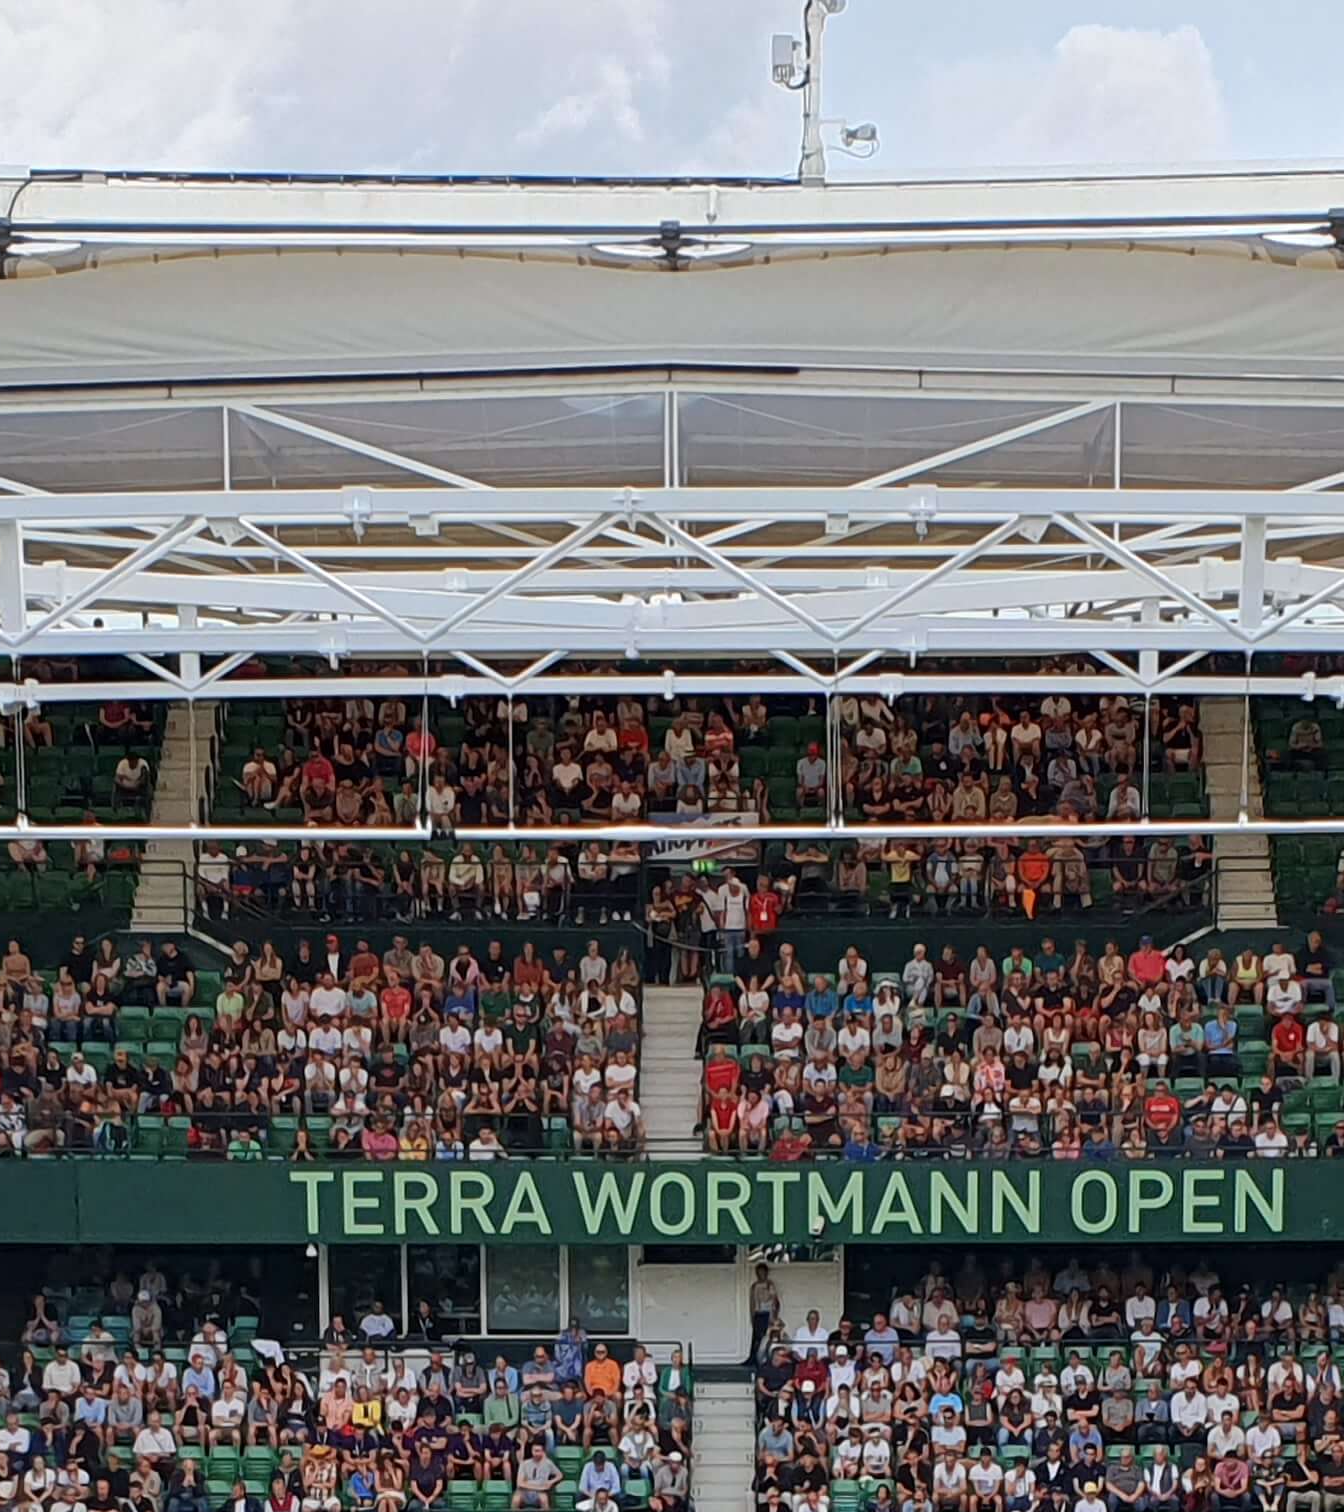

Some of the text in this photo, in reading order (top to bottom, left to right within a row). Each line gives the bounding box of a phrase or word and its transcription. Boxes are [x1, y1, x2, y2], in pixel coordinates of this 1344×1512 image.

[290, 1168, 1284, 1235] TERRA WORTMANN OPEN
